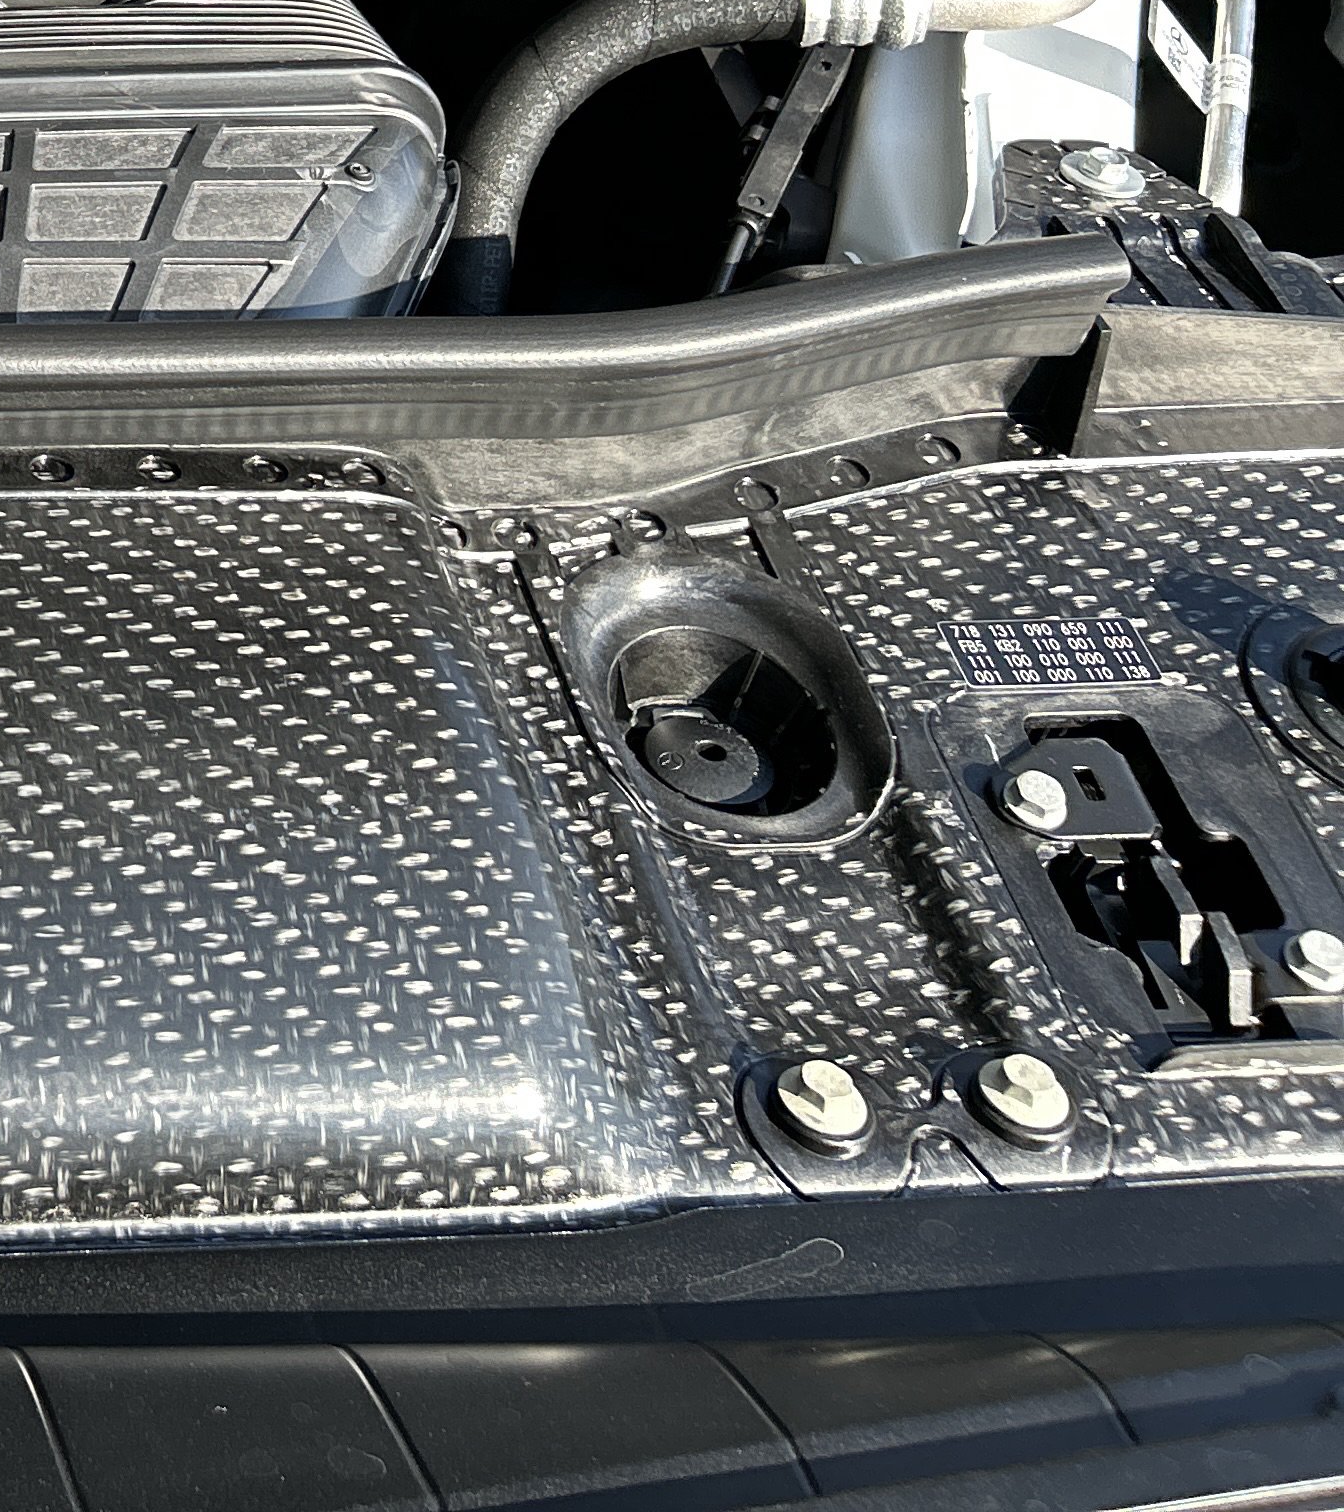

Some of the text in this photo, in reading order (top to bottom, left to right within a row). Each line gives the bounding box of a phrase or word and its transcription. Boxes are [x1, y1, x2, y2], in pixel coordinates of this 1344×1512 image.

[950, 625, 980, 638] 718
[988, 624, 1016, 637] 131
[1023, 623, 1052, 637] 090
[1096, 621, 1124, 634] 111
[958, 636, 1133, 653] FB5 KB2 110 001 000
[967, 651, 1142, 668] 111 100 010 000 111
[974, 670, 1003, 683] 001
[1012, 670, 1041, 683] 100
[1047, 668, 1077, 681] 000
[1085, 667, 1114, 680] 110
